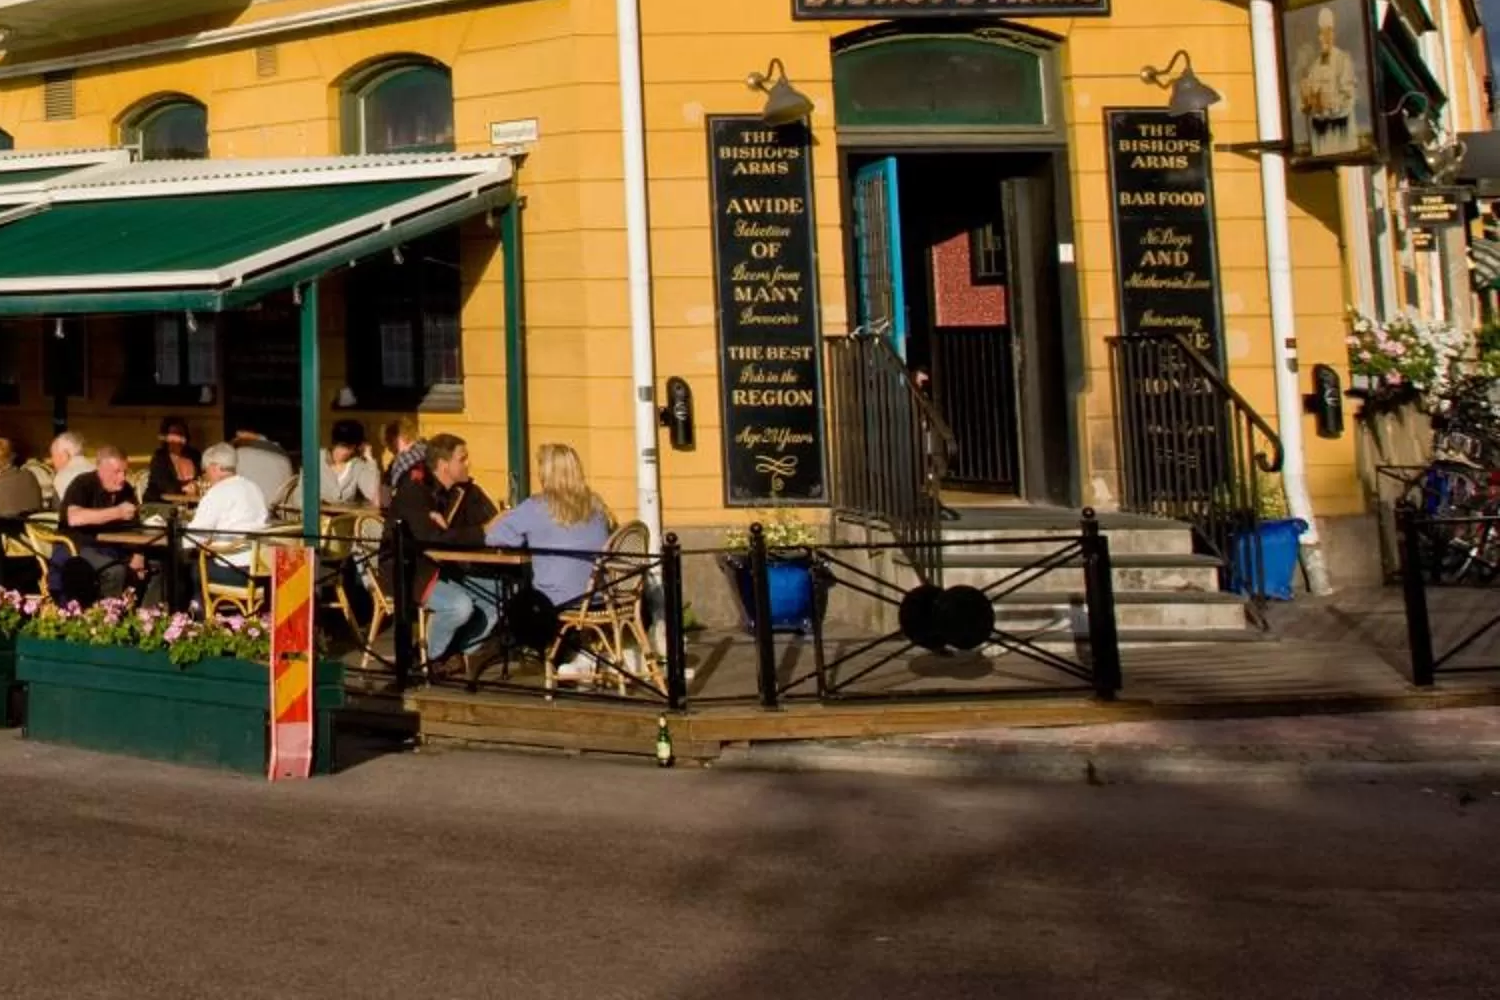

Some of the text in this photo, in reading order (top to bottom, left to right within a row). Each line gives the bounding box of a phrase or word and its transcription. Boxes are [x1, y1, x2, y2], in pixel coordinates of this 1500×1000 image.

[740, 131, 779, 144] THE
[1138, 123, 1177, 137] THE
[719, 145, 800, 159] BISHOPS
[1119, 139, 1201, 153] BISHOPS
[731, 161, 789, 176] ARMS
[1130, 155, 1189, 169] ARMS
[726, 197, 804, 215] A WIDE
[1119, 191, 1206, 207] BAR FOOD
[733, 218, 791, 238] Selection
[751, 241, 782, 259] OF
[1140, 249, 1189, 268] AND
[731, 261, 800, 288] Beers from
[734, 286, 803, 303] MANY
[727, 345, 813, 361] THE BEST
[779, 368, 799, 384] the
[731, 388, 814, 407] REGION
